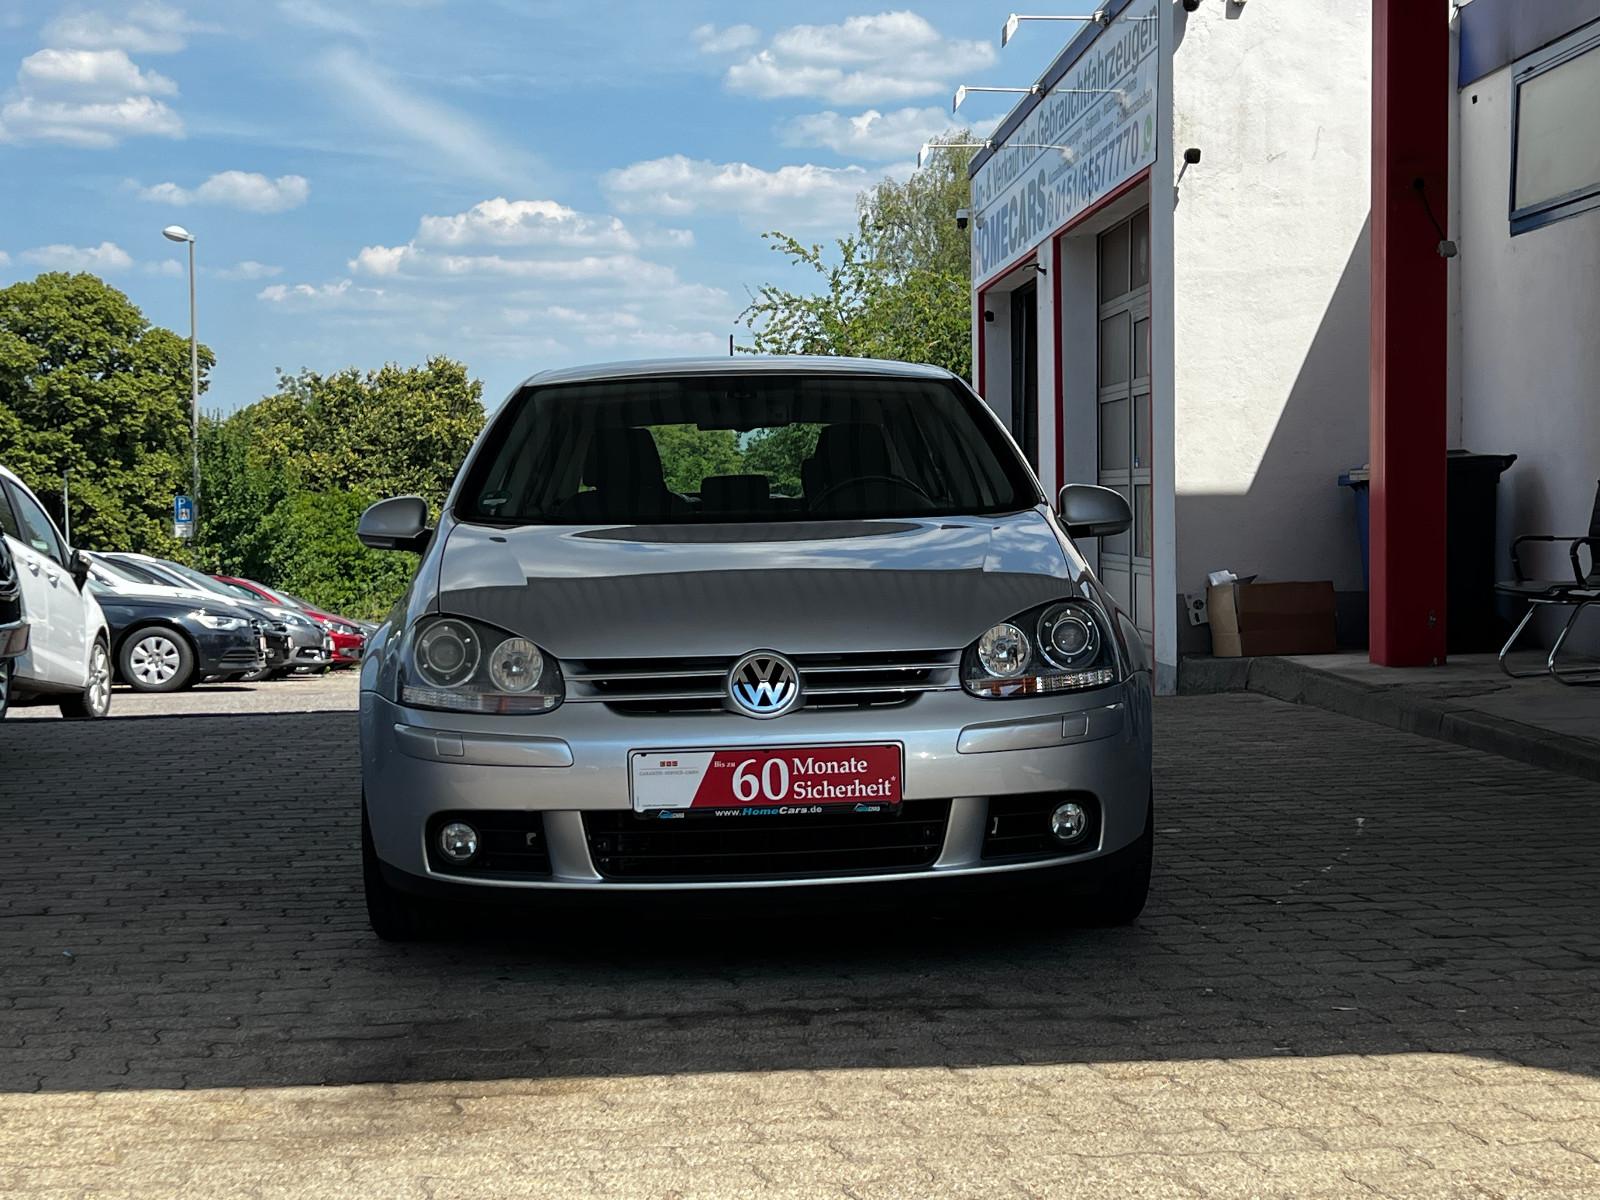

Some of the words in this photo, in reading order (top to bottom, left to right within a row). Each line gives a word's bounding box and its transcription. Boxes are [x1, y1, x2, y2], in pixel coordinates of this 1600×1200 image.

[993, 136, 1020, 195] Verkauf
[1021, 129, 1036, 168] von
[1038, 5, 1158, 150] Gebrauchtfahrzeugen
[178, 497, 186, 508] P
[732, 654, 797, 714] VW
[732, 757, 790, 802] 60
[792, 757, 868, 776] Monate
[714, 805, 823, 817] www.HomeCars.de
